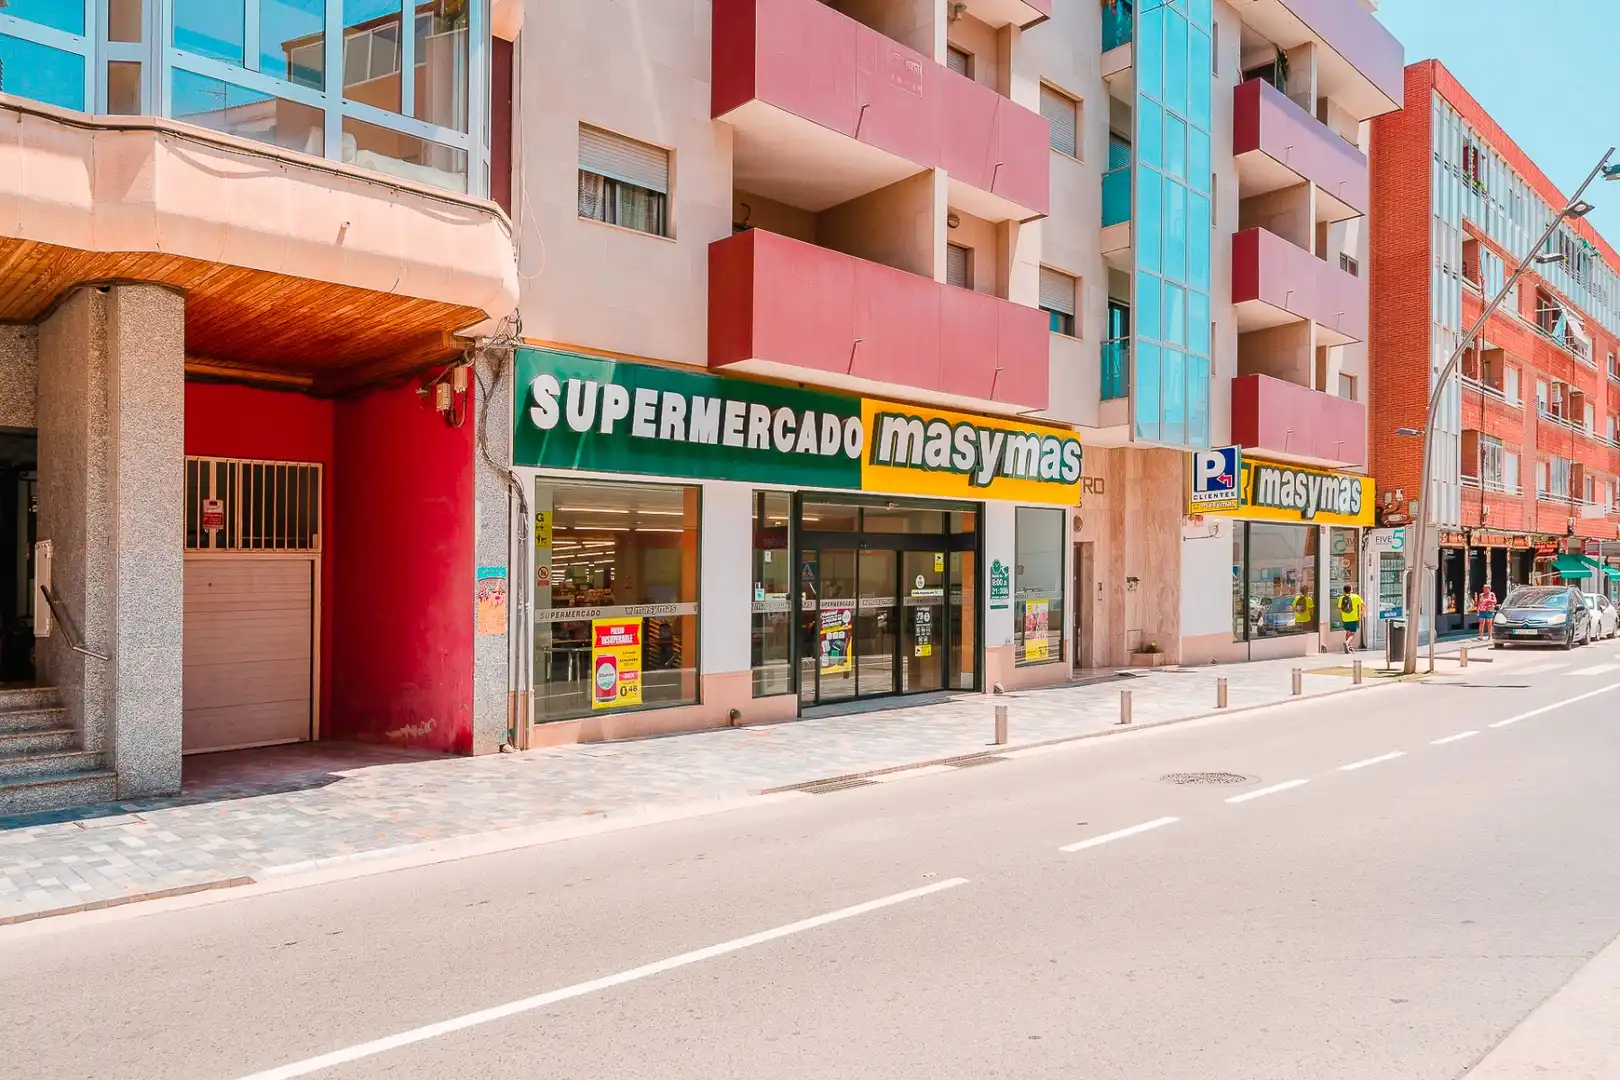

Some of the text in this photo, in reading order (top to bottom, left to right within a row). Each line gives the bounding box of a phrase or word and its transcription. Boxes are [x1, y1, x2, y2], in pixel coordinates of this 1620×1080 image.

[529, 374, 864, 459] SUPERMERCADO
[876, 413, 1082, 486] masymas
[1197, 451, 1226, 491] P
[1193, 492, 1235, 500] CLIENTES
[1257, 466, 1362, 519] masymas
[1375, 529, 1404, 549] FIVE 5
[540, 604, 677, 619] SUPERMERCADO masymas
